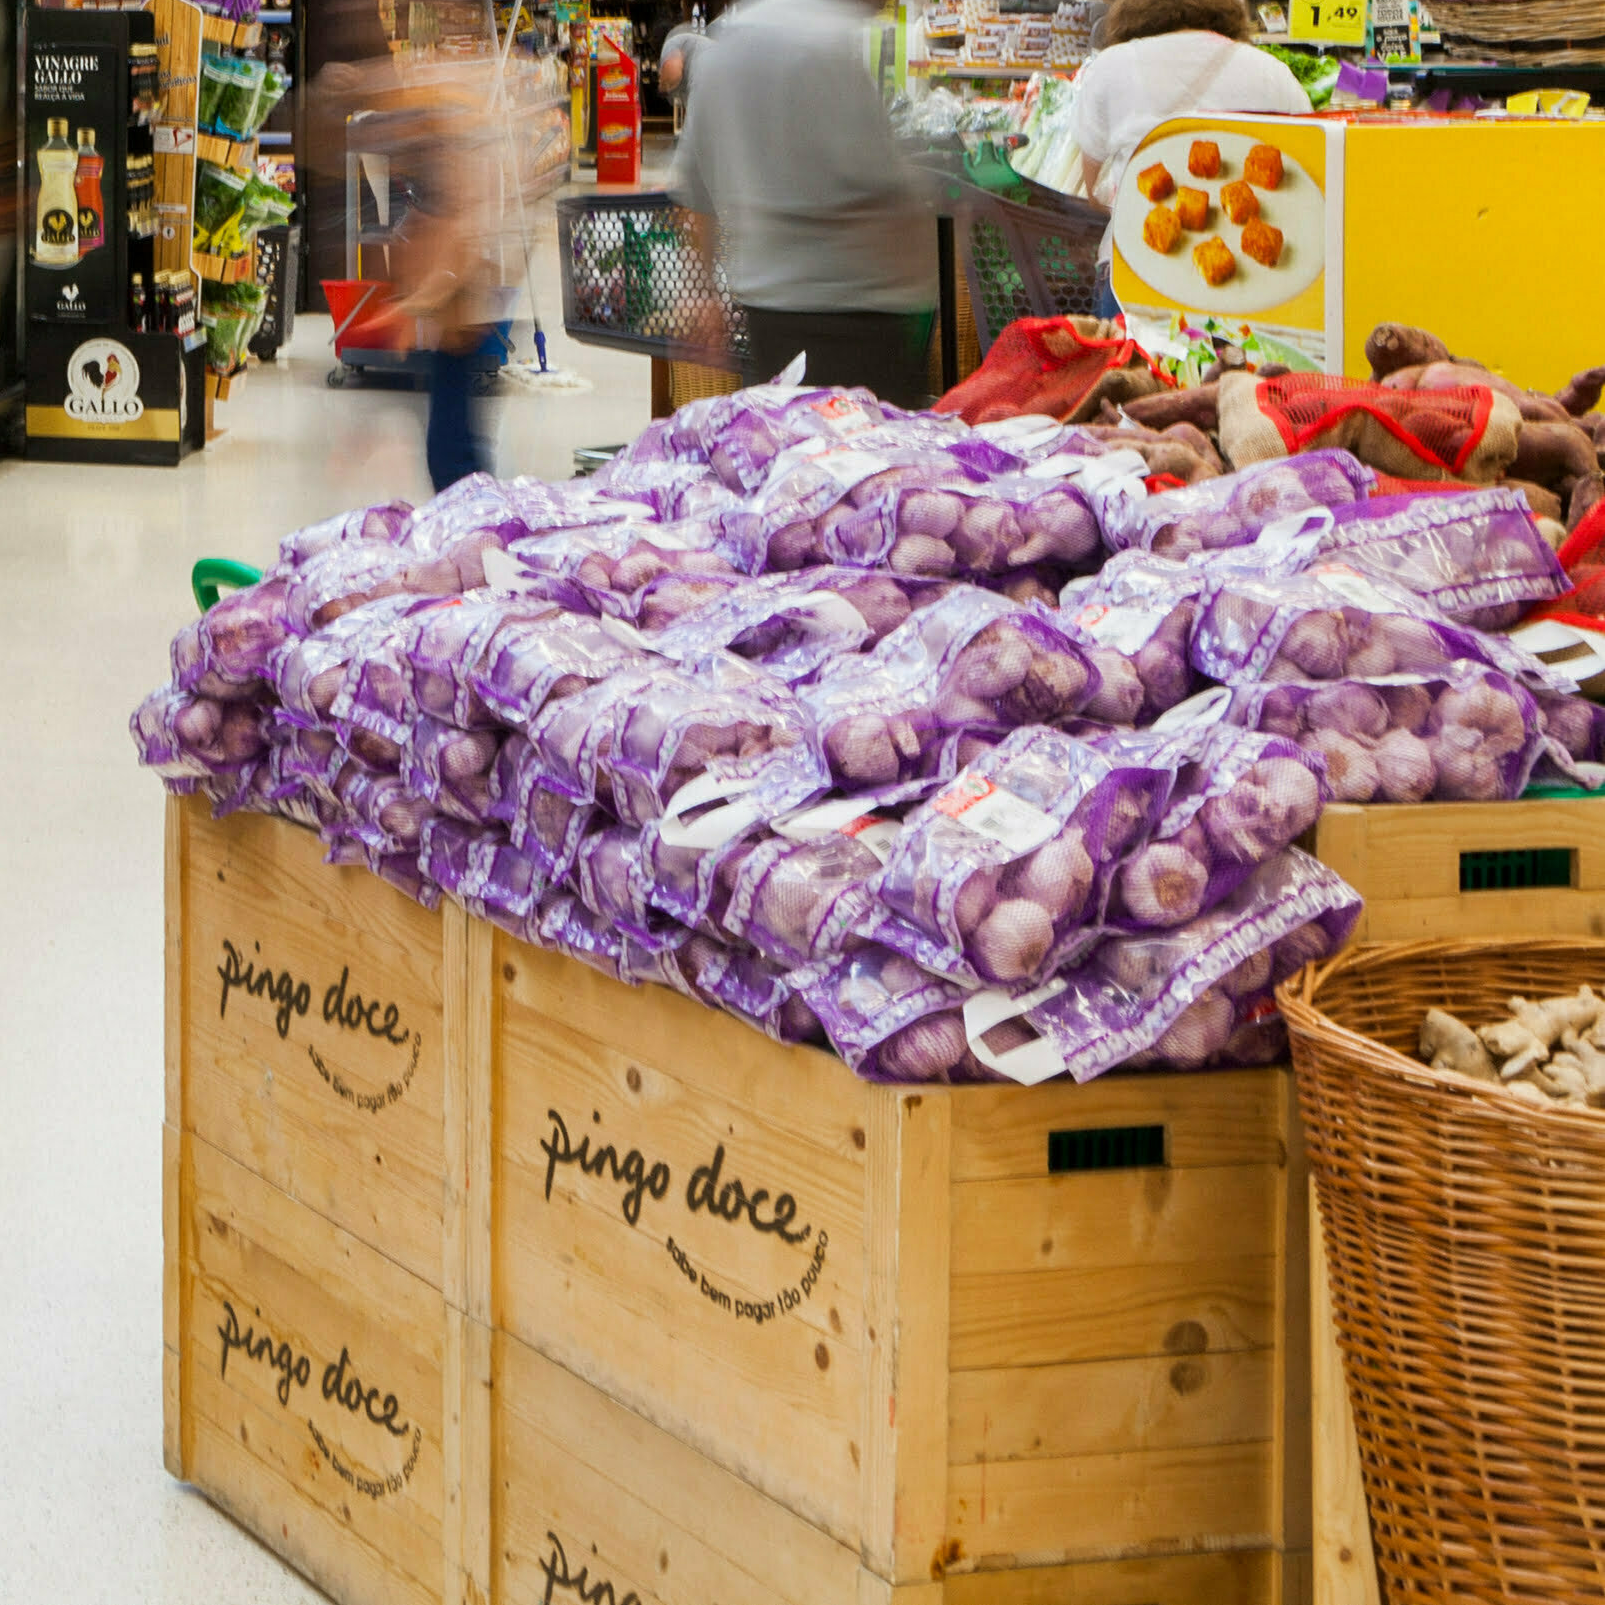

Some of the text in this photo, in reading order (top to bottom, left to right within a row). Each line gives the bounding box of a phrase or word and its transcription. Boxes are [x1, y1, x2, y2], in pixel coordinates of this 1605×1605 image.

[35, 55, 99, 72] VINAGRE
[35, 70, 82, 85] GALLO
[56, 301, 87, 312] GALLO
[69, 396, 139, 417] GALLO
[218, 939, 409, 1045] pingo doce
[308, 1043, 330, 1084] sabe
[332, 1072, 355, 1103] bem
[357, 1093, 386, 1114] pagar
[403, 1031, 421, 1090] pouco
[540, 1108, 810, 1244] pingo doce
[666, 1229, 829, 1324] sabe bem pagar tão pouco
[218, 1301, 409, 1437] pingo doce
[308, 1419, 330, 1461] sabe
[332, 1453, 355, 1487] bem
[357, 1476, 386, 1501] pagar
[402, 1427, 422, 1484] pouco
